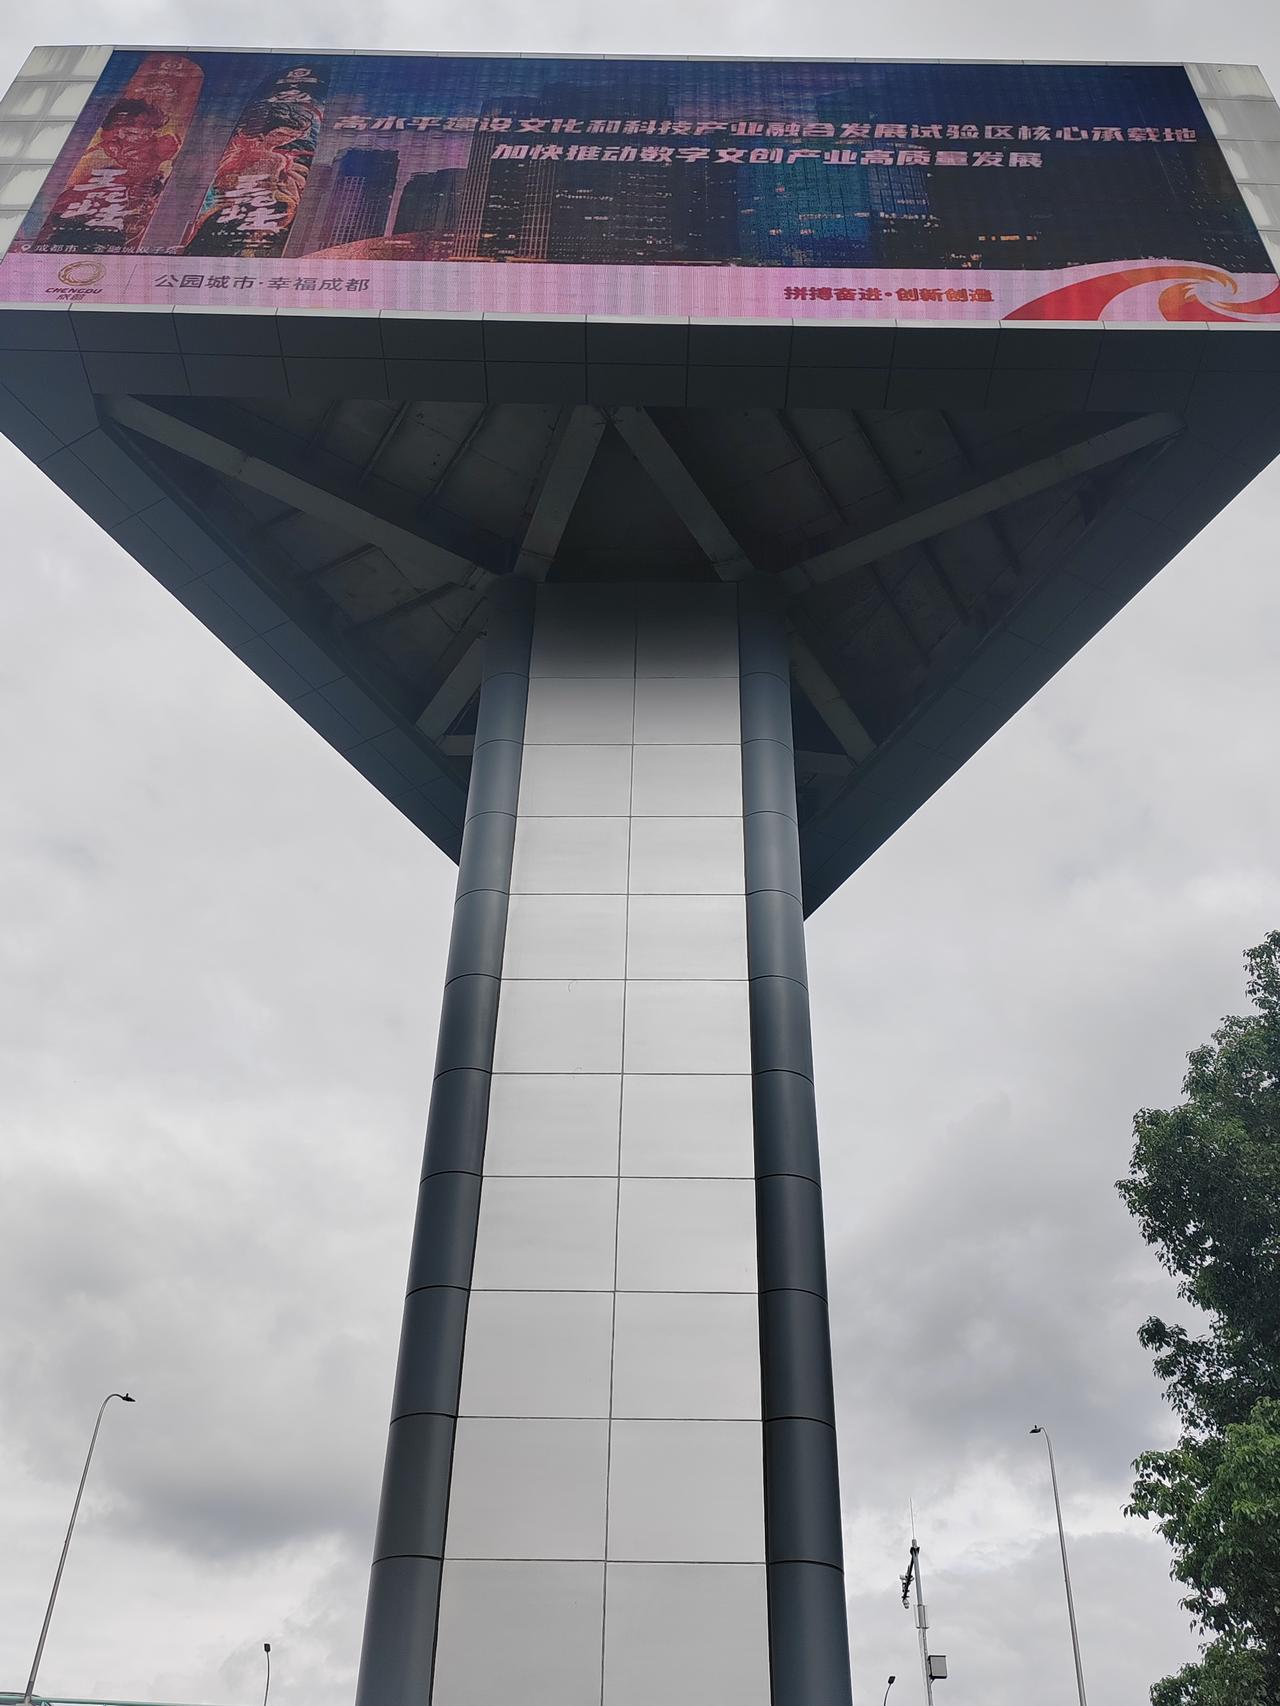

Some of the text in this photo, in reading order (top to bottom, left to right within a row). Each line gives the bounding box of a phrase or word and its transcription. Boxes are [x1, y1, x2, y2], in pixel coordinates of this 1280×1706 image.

[333, 116, 1197, 143] 高水平建设文化和科技产业融合发展试验区核心承载地
[491, 144, 1043, 168] 加快推动数字文创产业高质量发展
